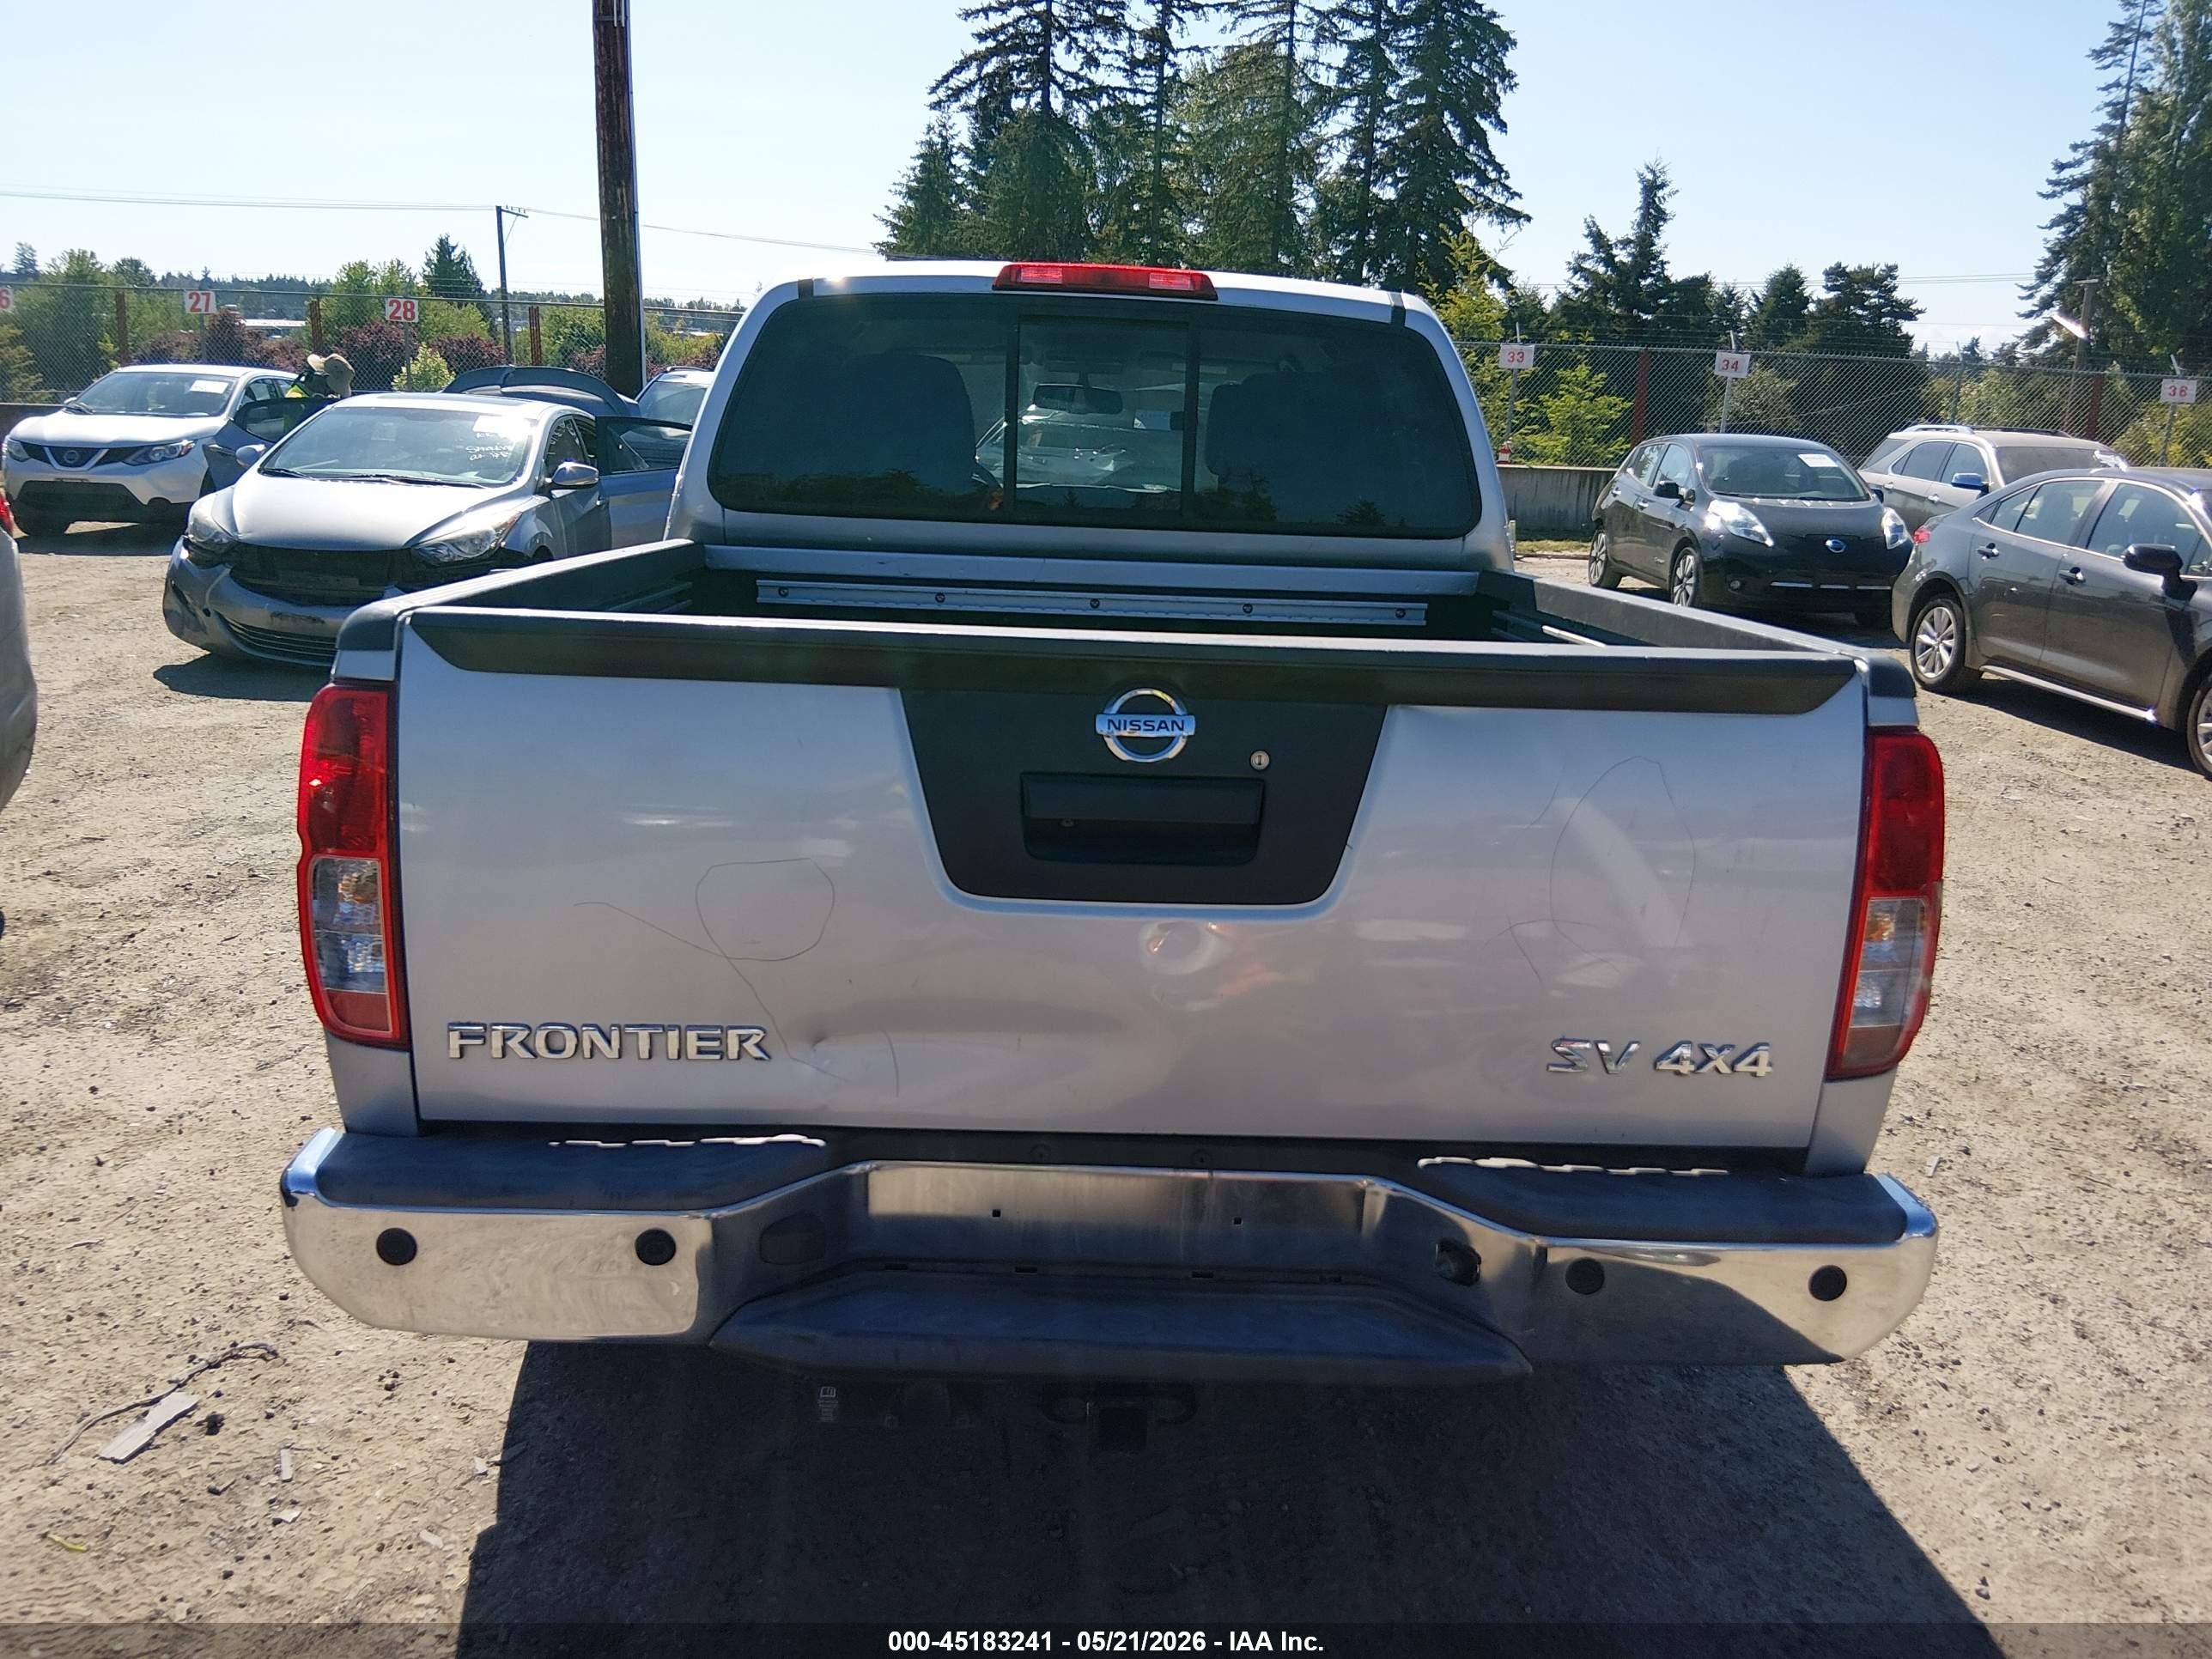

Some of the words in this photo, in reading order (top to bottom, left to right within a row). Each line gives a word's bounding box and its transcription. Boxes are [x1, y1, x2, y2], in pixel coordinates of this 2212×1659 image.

[188, 292, 210, 312] 27
[389, 300, 416, 320] 28
[1507, 351, 1525, 362] 33
[1722, 359, 1739, 372] 34
[2169, 385, 2188, 397] 36
[1108, 719, 1185, 732] NISSAN
[447, 1022, 771, 1060] FRONTIER
[1547, 1037, 1641, 1074] SV
